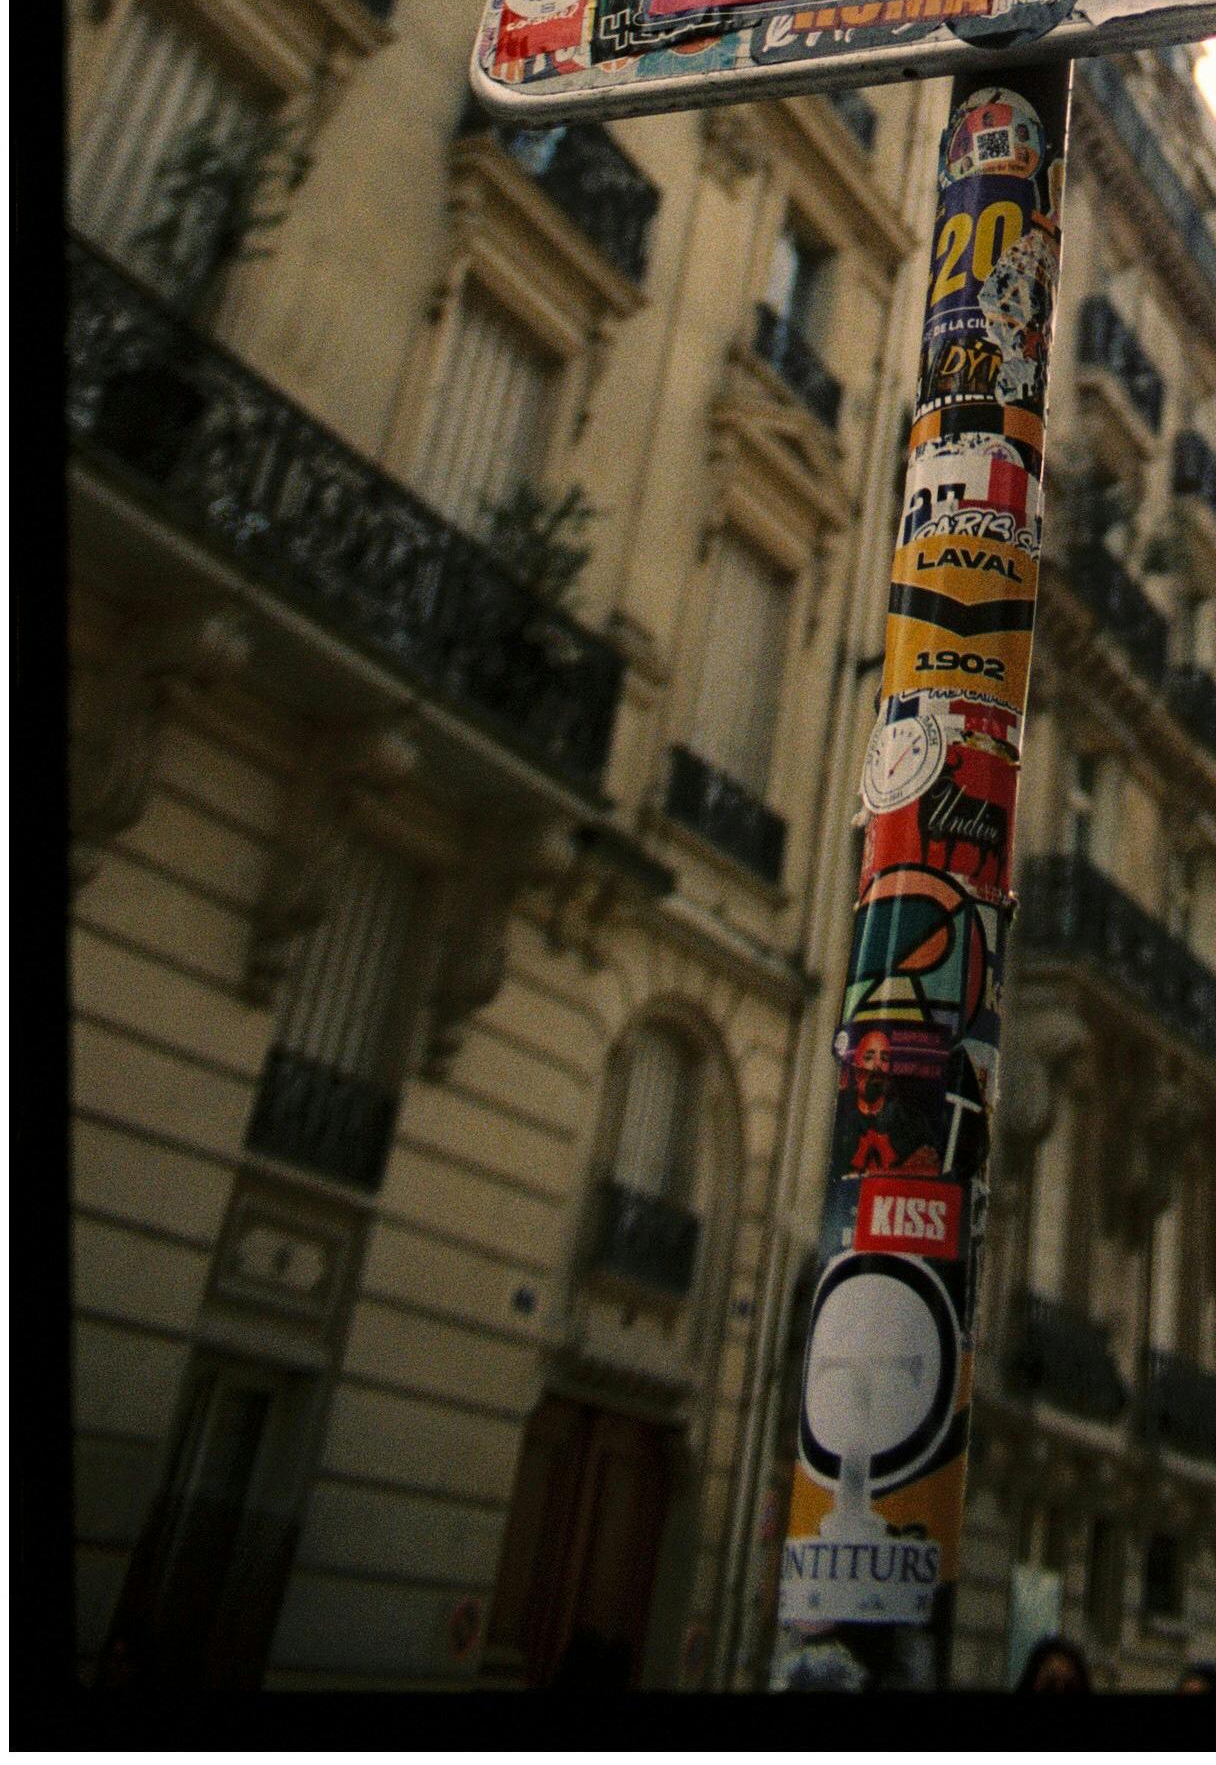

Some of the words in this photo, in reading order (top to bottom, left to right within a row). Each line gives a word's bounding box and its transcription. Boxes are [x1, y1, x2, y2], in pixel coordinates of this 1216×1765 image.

[948, 318, 966, 332] LA
[916, 548, 1023, 584] LAVAL
[914, 650, 1007, 682] 1902
[869, 1194, 947, 1241] KISS
[781, 1543, 939, 1583] NTITURS
